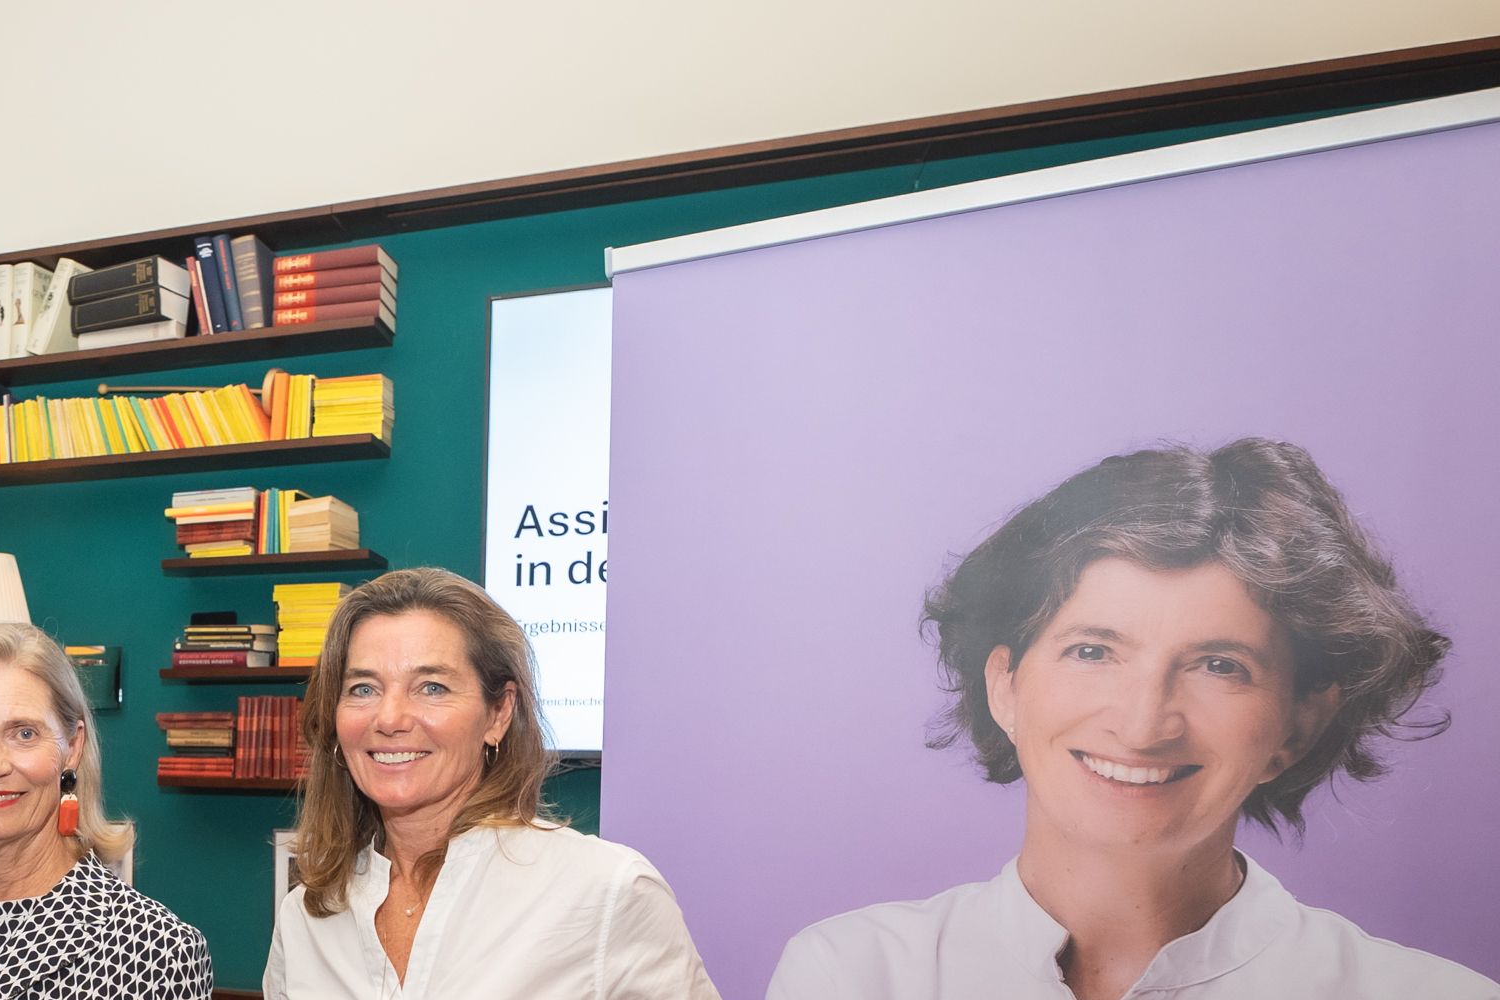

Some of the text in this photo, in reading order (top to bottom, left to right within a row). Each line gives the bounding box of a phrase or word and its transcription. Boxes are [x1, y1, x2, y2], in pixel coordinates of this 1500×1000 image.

[514, 500, 608, 538] Assi
[515, 553, 551, 587] in
[516, 618, 605, 637] rgebnisse
